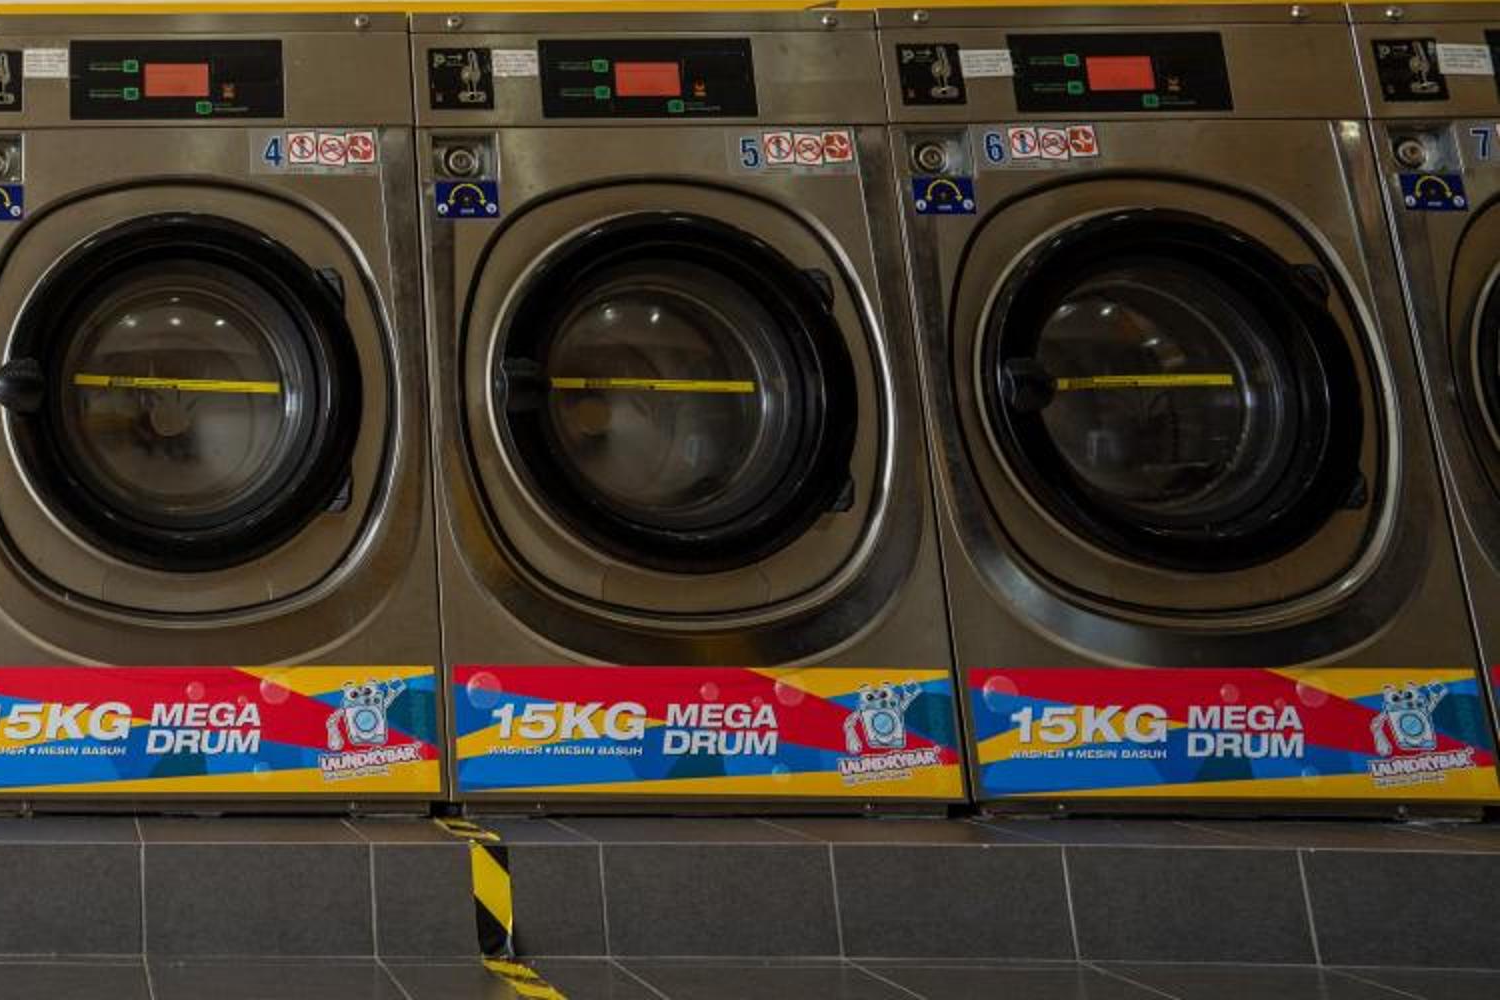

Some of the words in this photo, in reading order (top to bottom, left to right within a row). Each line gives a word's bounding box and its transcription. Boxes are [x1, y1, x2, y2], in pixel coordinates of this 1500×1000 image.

[263, 135, 283, 167] 4
[740, 138, 760, 168] 5
[984, 131, 1005, 165] 6
[1470, 128, 1492, 160] 7
[1011, 704, 1167, 743] 15KG
[1188, 706, 1303, 730] MEGA
[1188, 733, 1304, 758] DRUM
